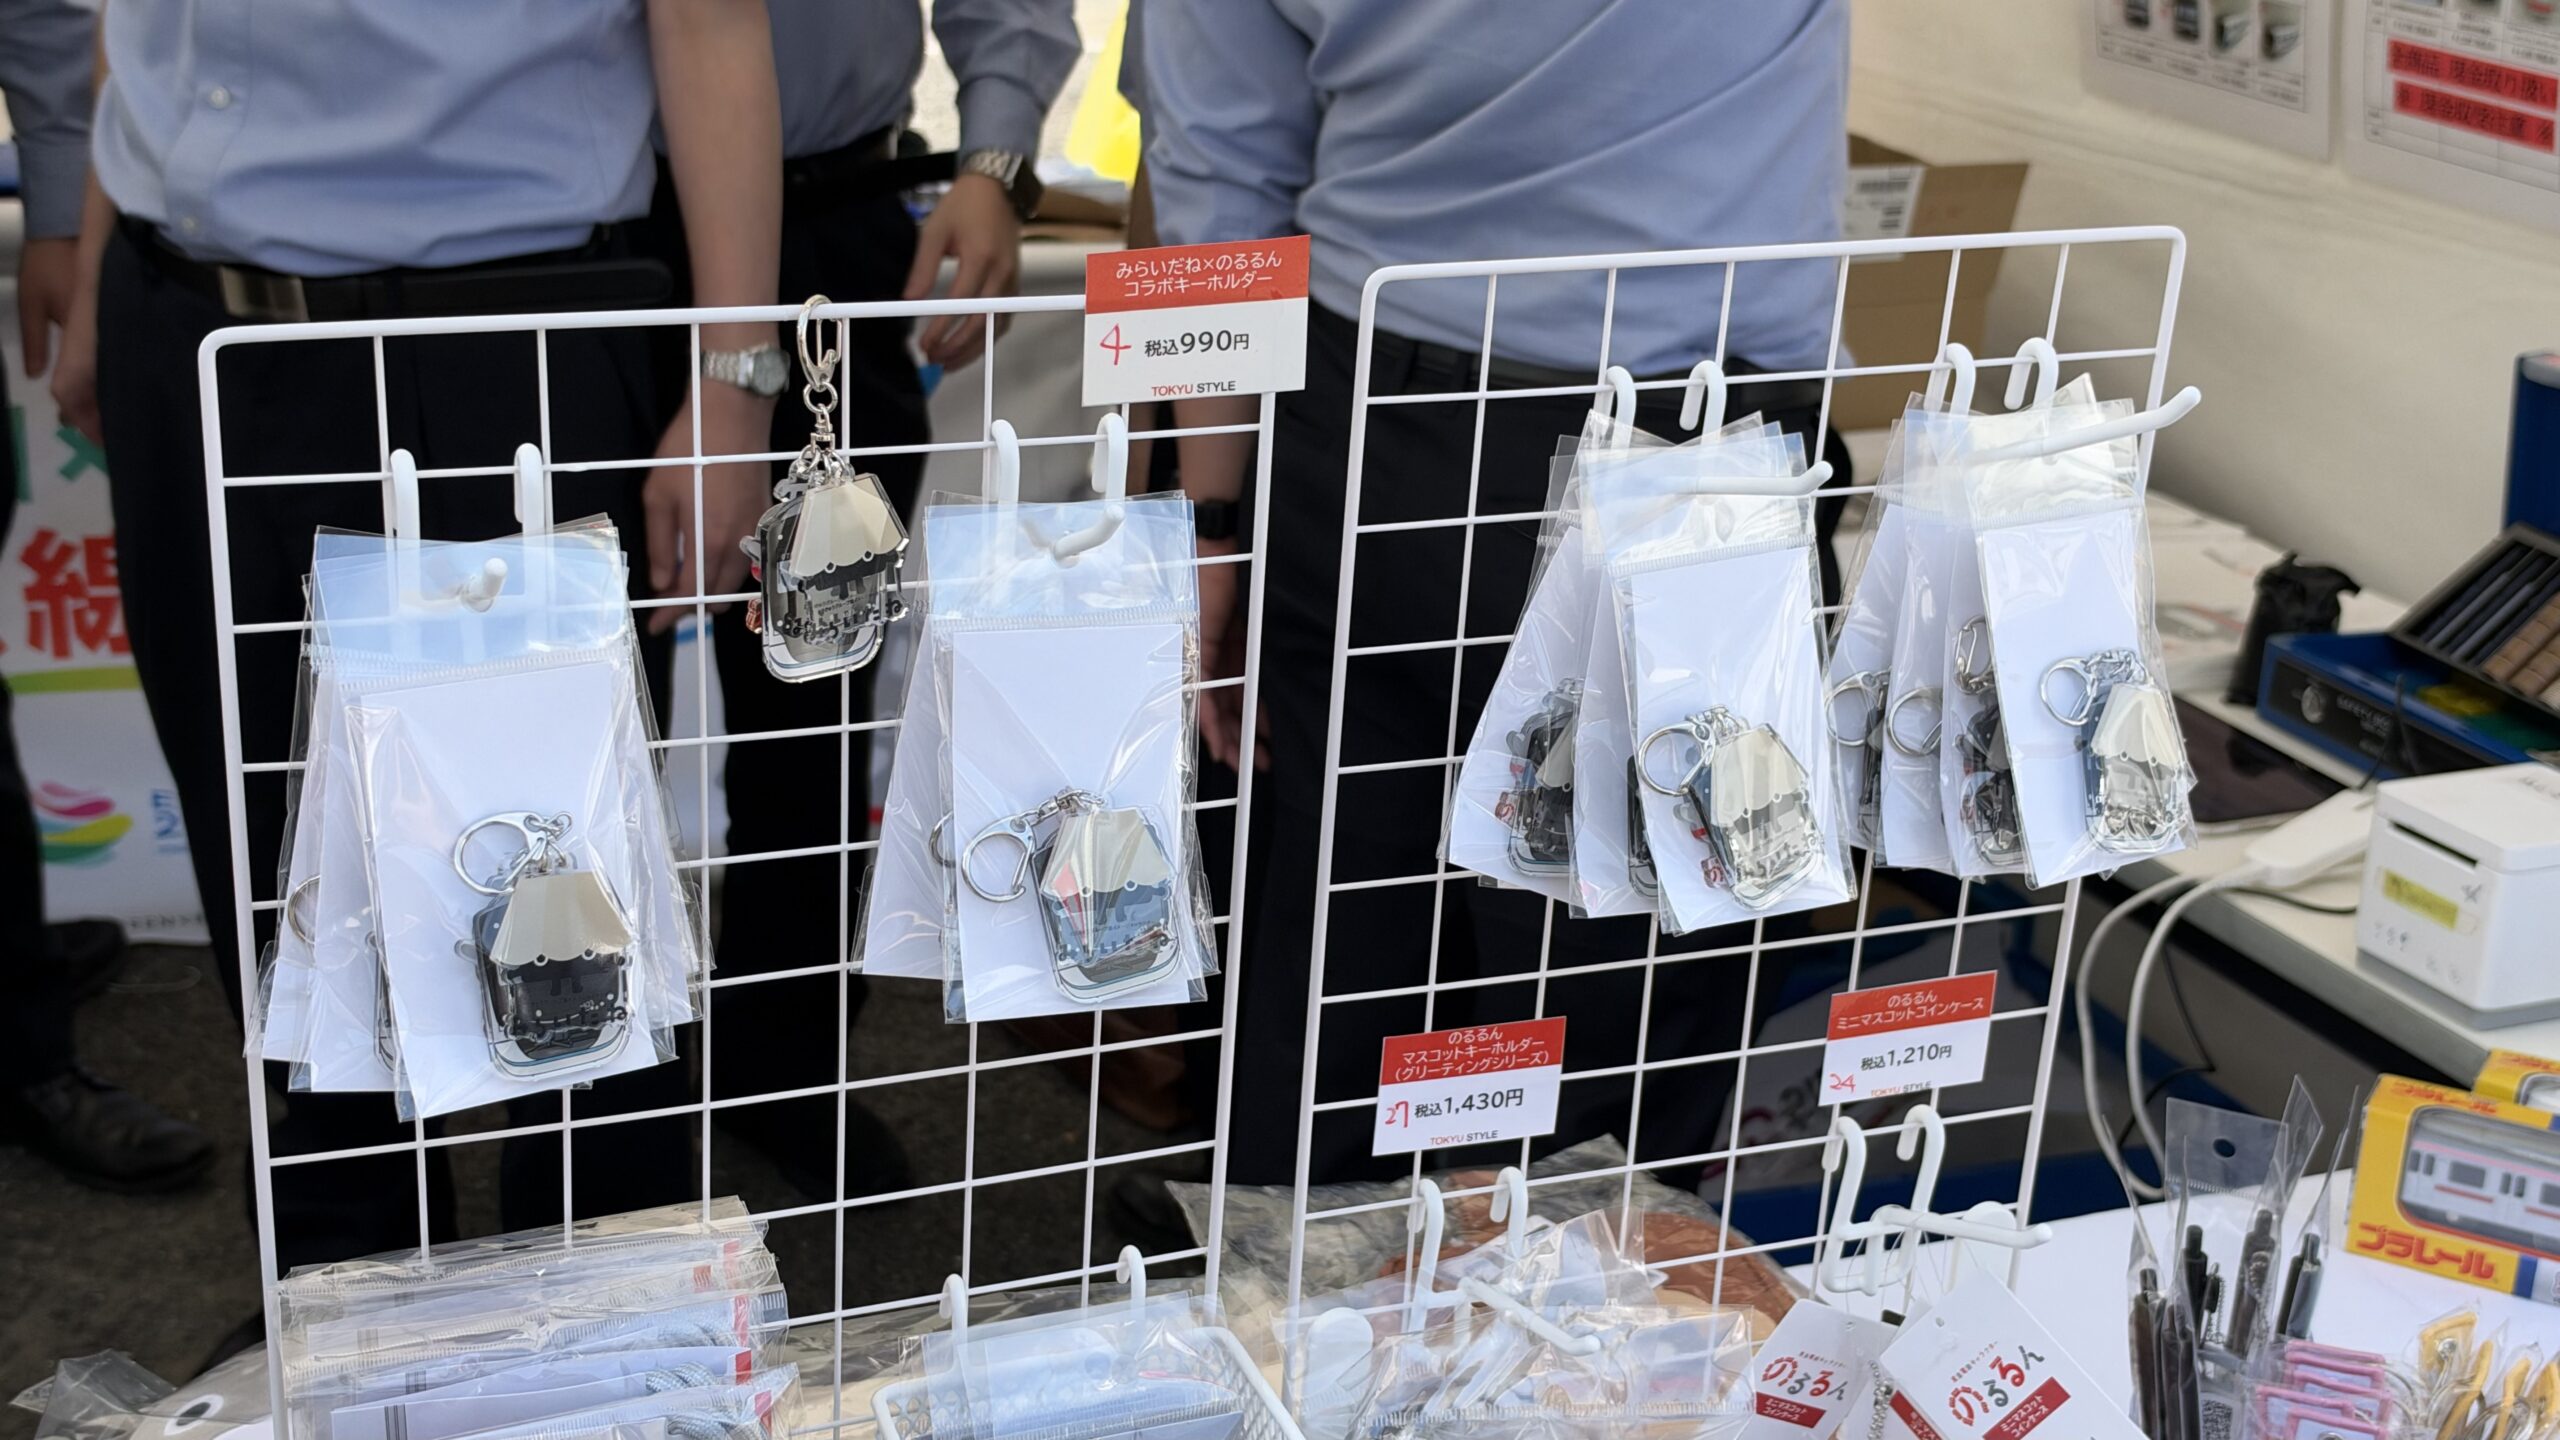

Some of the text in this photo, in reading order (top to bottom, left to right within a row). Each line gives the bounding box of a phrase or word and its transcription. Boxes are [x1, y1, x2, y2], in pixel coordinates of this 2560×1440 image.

[1116, 250, 1282, 280] みらいだね×のるるん
[1124, 271, 1273, 298] コラボキーホルダー
[1100, 323, 1132, 366] 4
[1144, 330, 1250, 357] 税込990円
[1151, 381, 1236, 397] TOKYU STYLE
[1836, 997, 1984, 1030] ミニマスコットコインケース
[1887, 990, 1938, 1009] のるるん
[1448, 1026, 1503, 1044] のるるん
[1403, 1039, 1545, 1063] マスコットキーホルダー
[1860, 1043, 1953, 1071] 税込1,210円
[1829, 1073, 1856, 1093] 24
[1870, 1080, 1932, 1097] TOKYU STYLE
[1385, 1100, 1410, 1128] 27
[1414, 1088, 1524, 1118] 税込1,430円
[1430, 1130, 1499, 1145] TOKYU STYLE
[2355, 1221, 2496, 1280] プラレール
[1761, 1356, 1848, 1401] のるるん
[1949, 1345, 2045, 1427] のるるん
[2000, 1394, 2044, 1432] ミニマスコット
